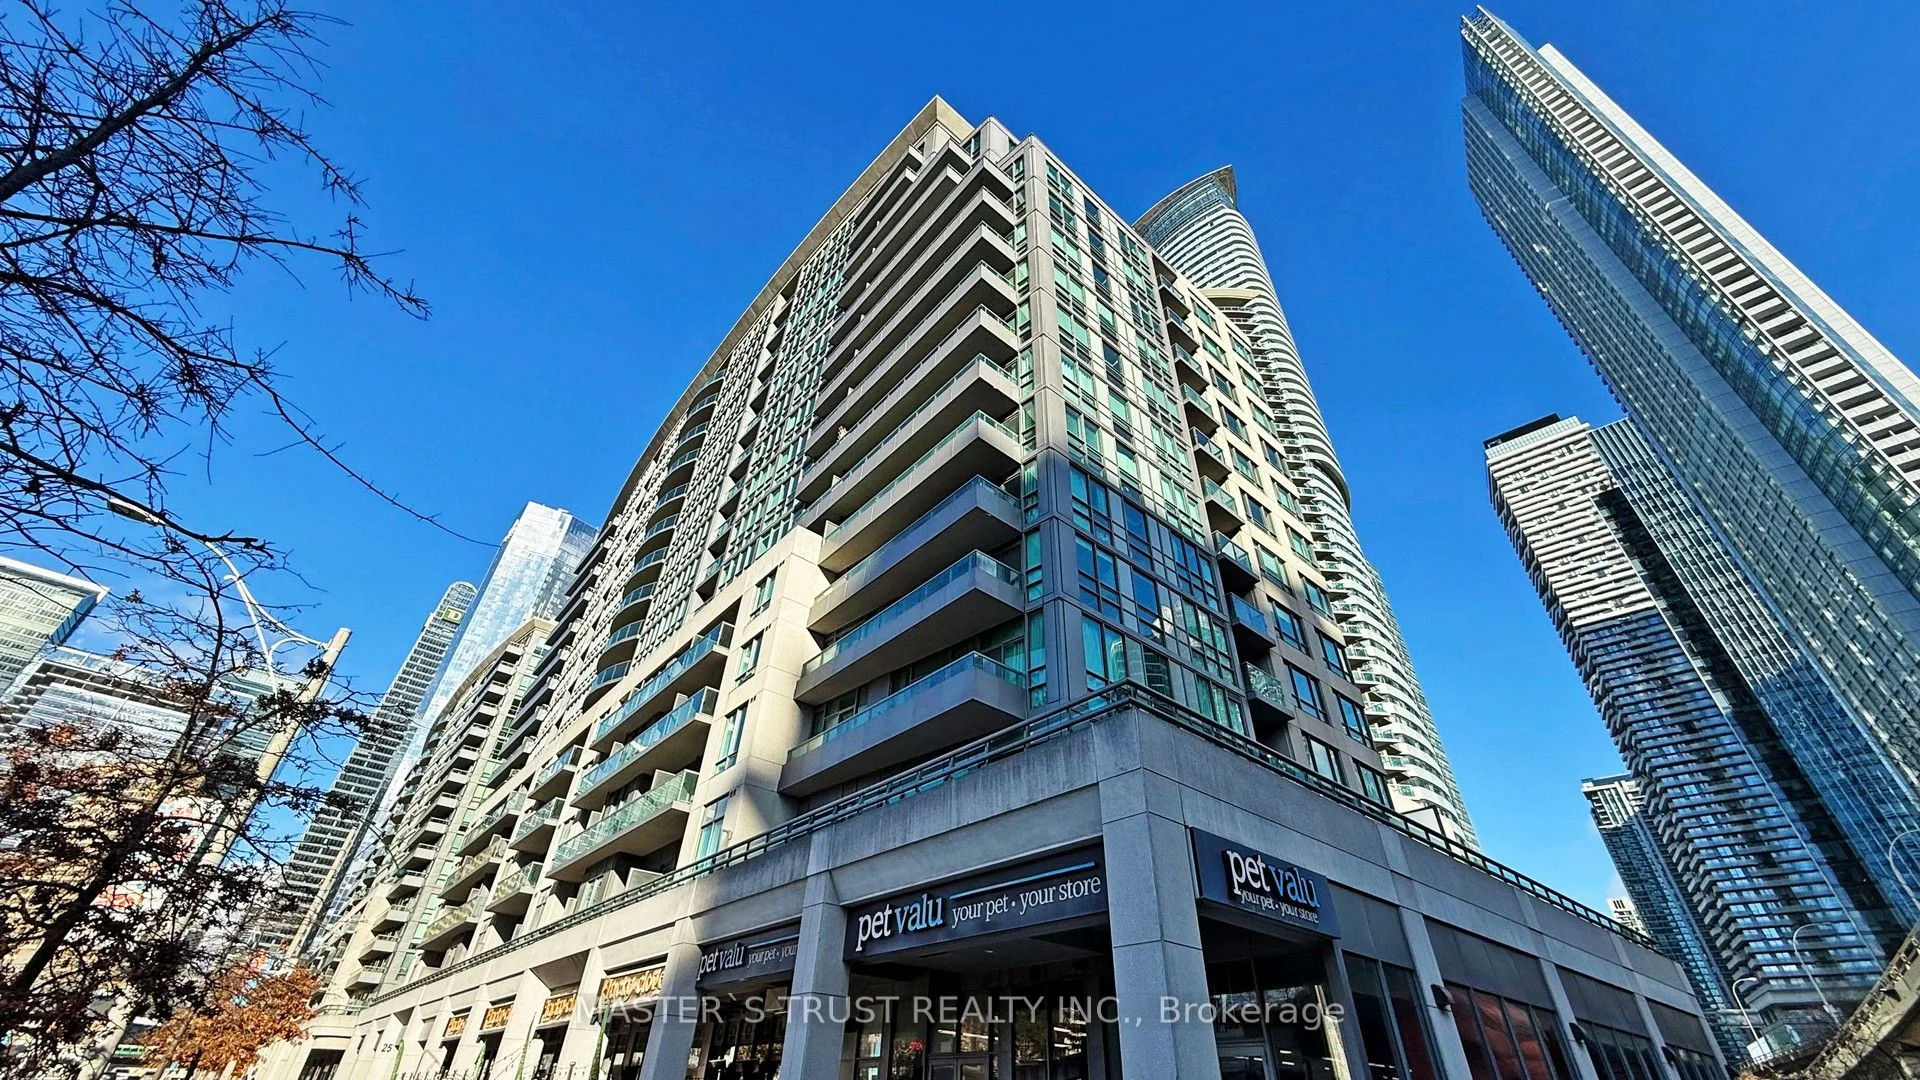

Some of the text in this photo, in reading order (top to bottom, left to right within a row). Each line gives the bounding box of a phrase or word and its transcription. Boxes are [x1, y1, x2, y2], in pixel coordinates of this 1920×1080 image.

[1226, 850, 1320, 908] pet valu
[951, 876, 1101, 929] your pet your store
[1240, 889, 1319, 924] your pet your store
[855, 893, 943, 952] pet valu
[696, 942, 745, 981] pet valu
[746, 951, 764, 969] your
[763, 948, 776, 965] pet
[381, 1043, 394, 1053] 25
